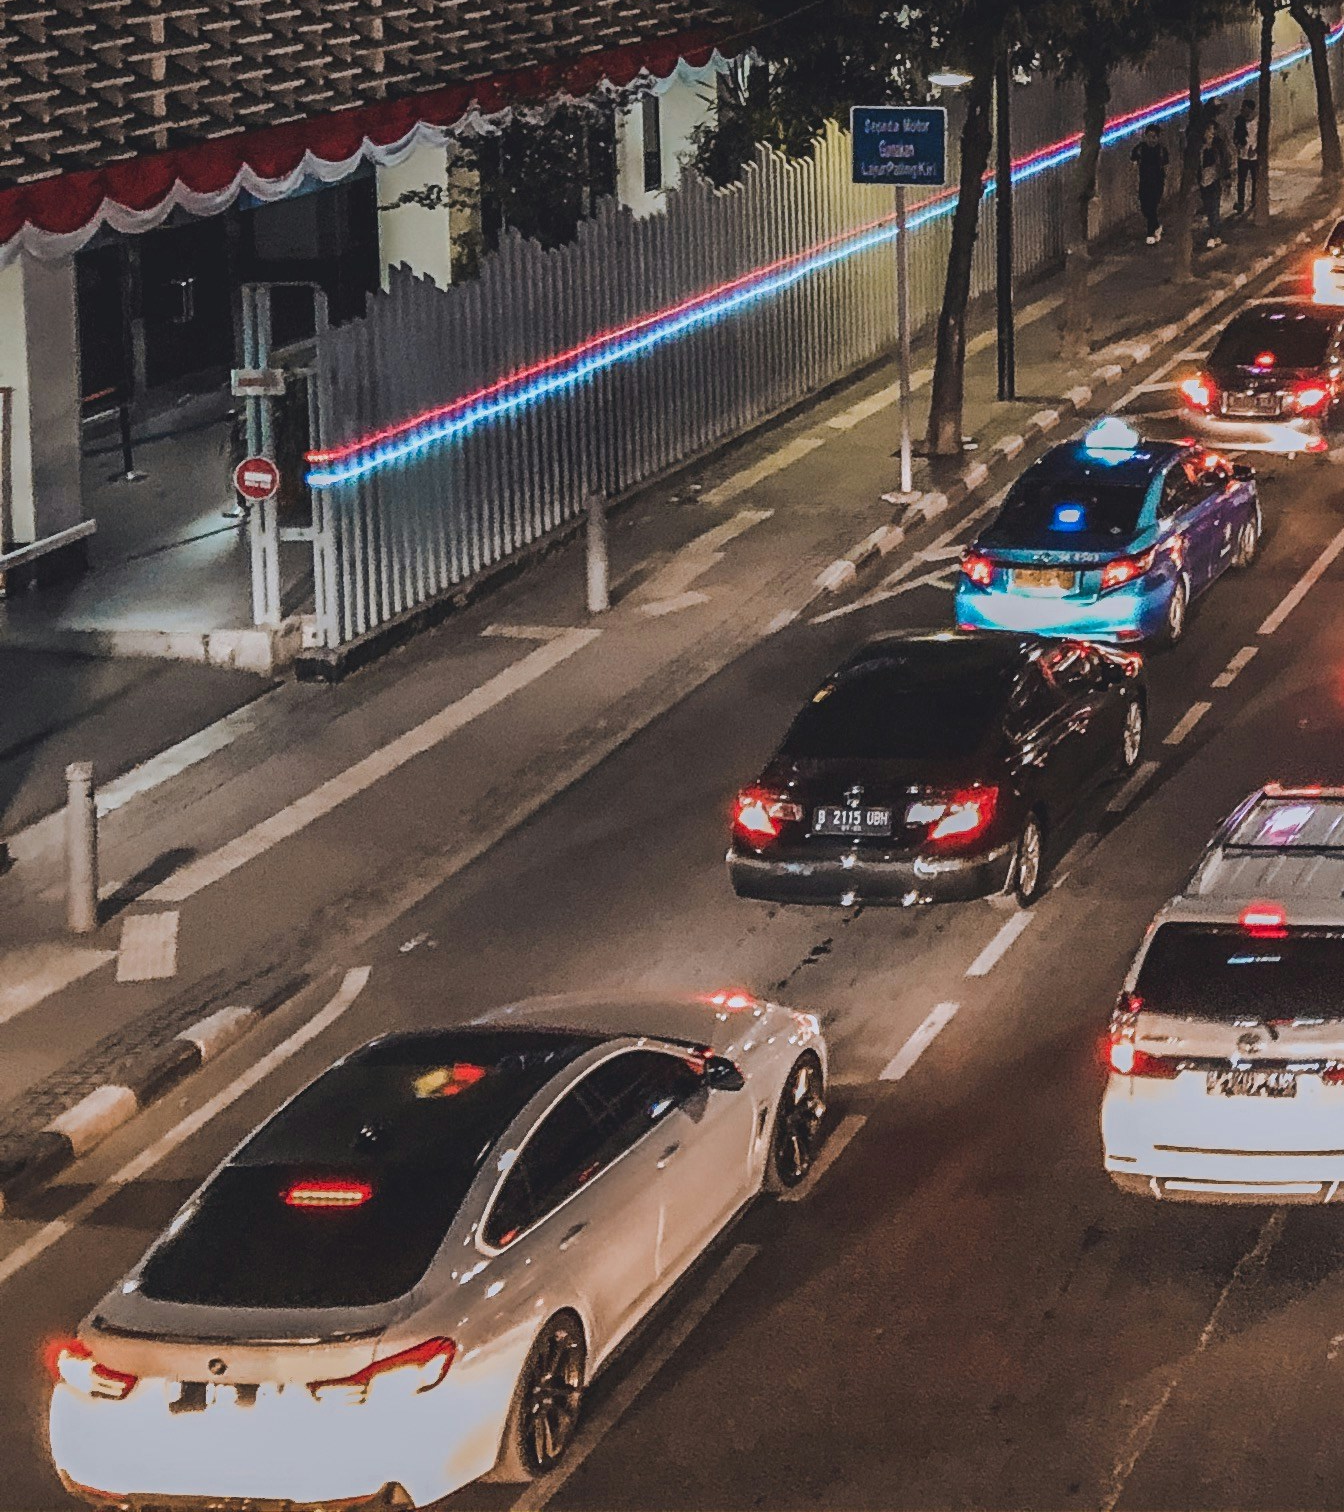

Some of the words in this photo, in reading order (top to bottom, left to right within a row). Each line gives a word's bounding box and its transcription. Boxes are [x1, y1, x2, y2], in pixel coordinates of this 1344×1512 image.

[903, 118, 931, 133] Motor
[818, 809, 826, 825] B
[833, 810, 862, 825] 2115
[866, 810, 890, 826] UBH
